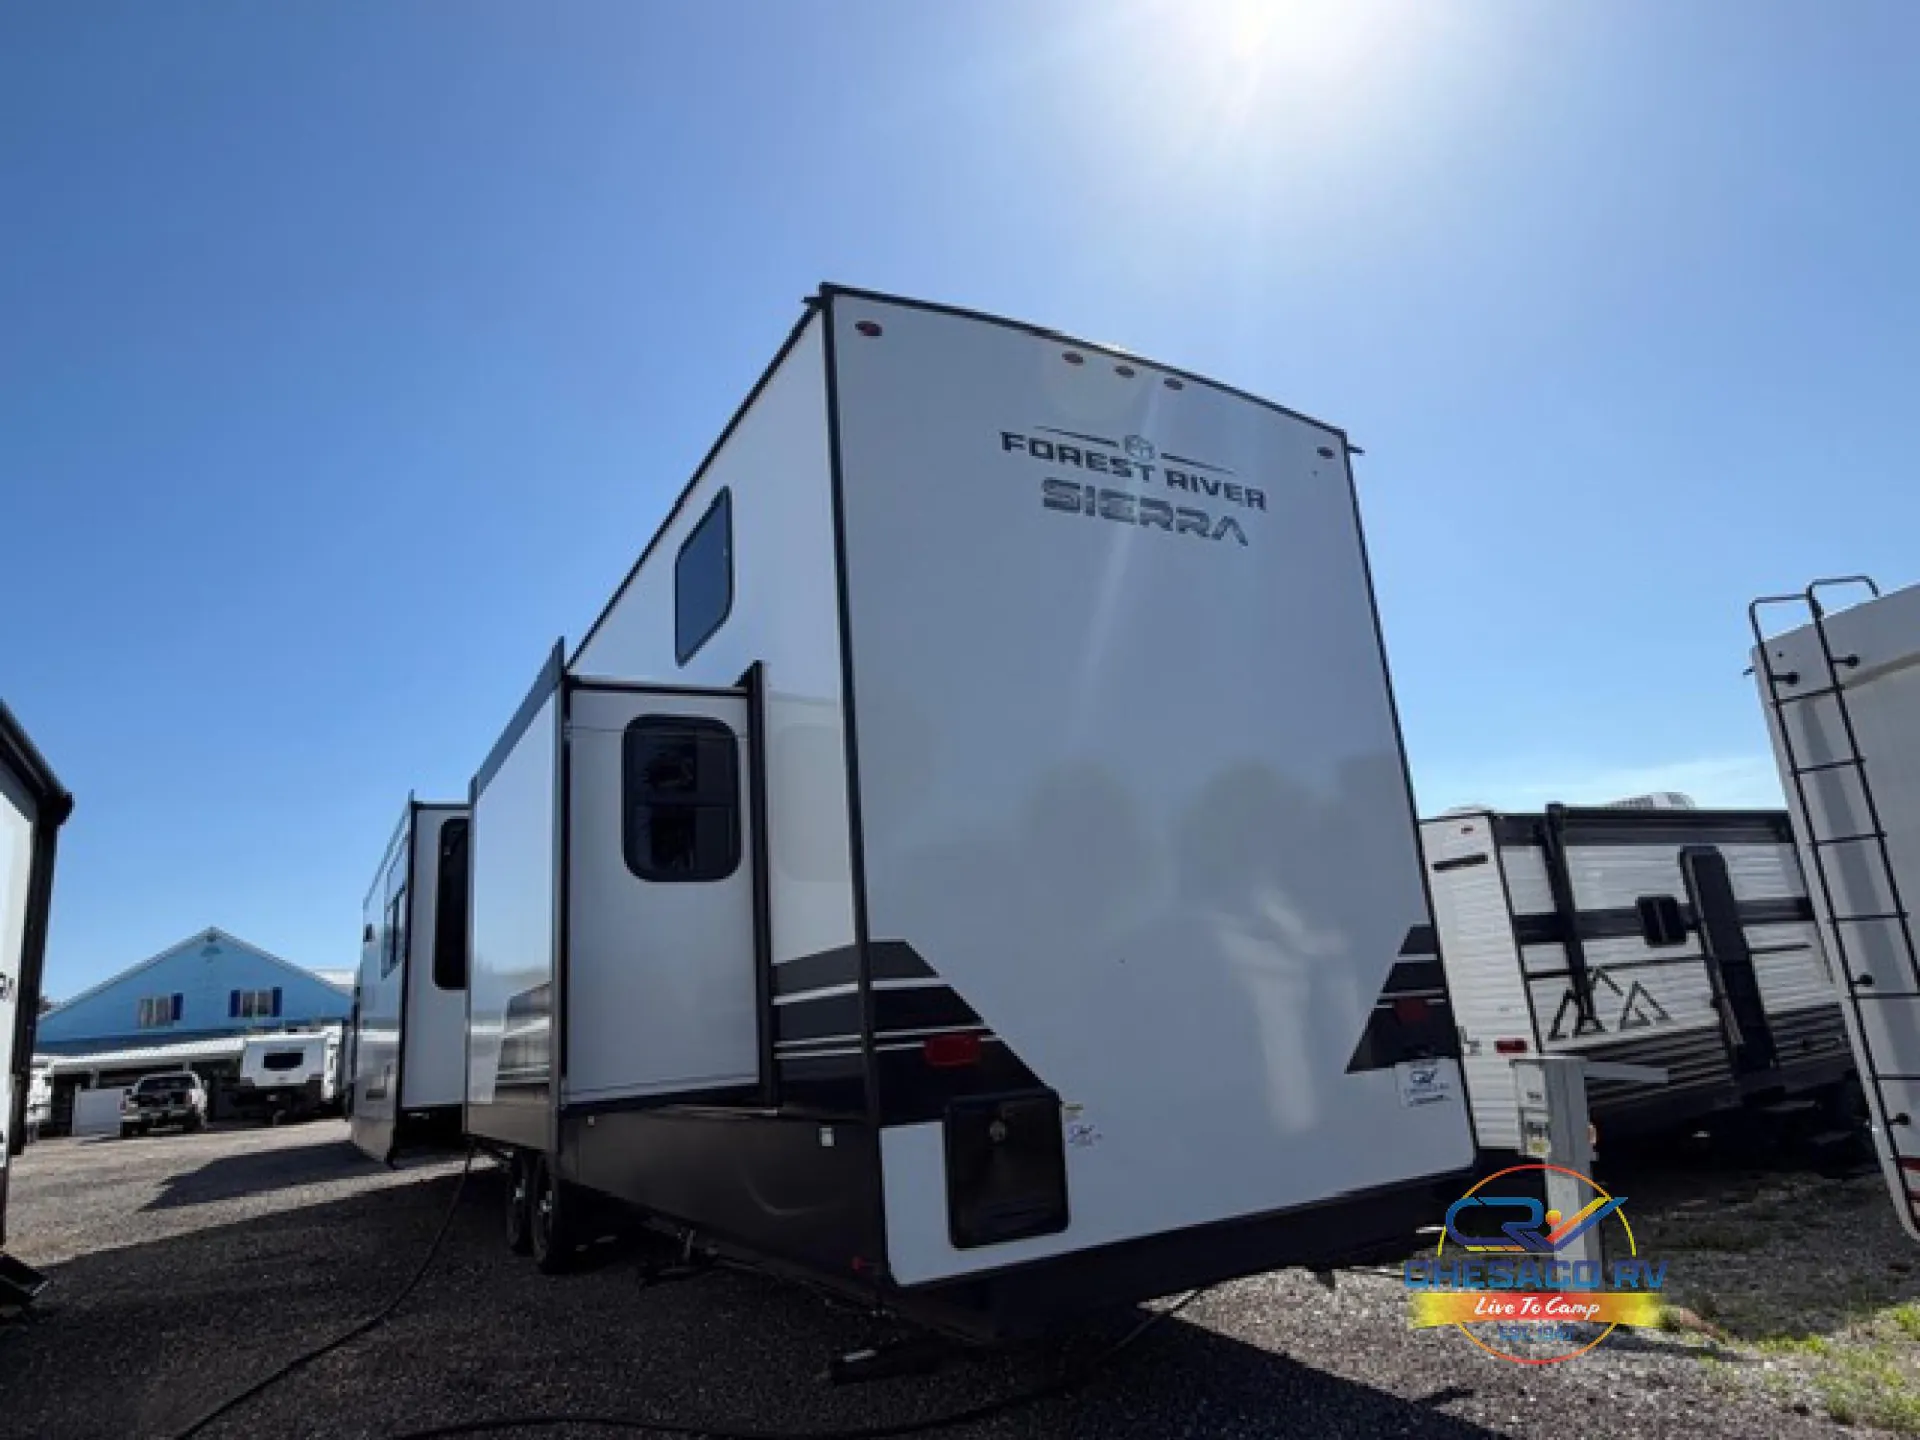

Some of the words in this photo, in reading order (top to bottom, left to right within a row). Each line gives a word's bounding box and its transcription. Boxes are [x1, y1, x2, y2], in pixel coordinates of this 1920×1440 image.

[1000, 431, 1154, 482] FOREST
[1163, 467, 1267, 511] RIVER
[1041, 477, 1249, 546] SIERRA
